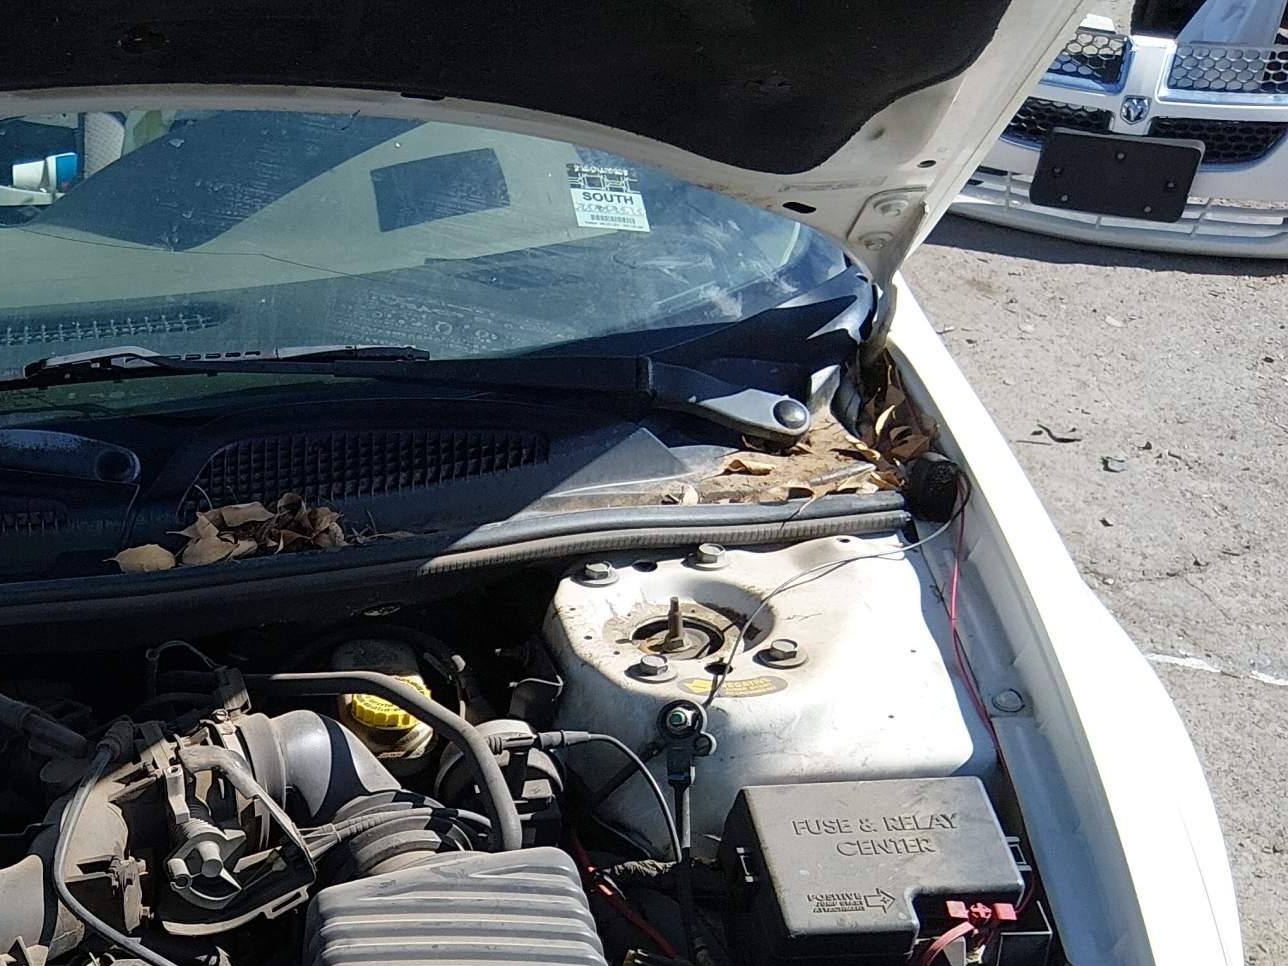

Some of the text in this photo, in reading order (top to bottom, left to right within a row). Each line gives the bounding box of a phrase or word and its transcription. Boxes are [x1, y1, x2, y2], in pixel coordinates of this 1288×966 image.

[582, 191, 634, 205] SOUTH
[792, 812, 959, 836] FUSE & RELAY
[836, 837, 936, 857] CENTER
